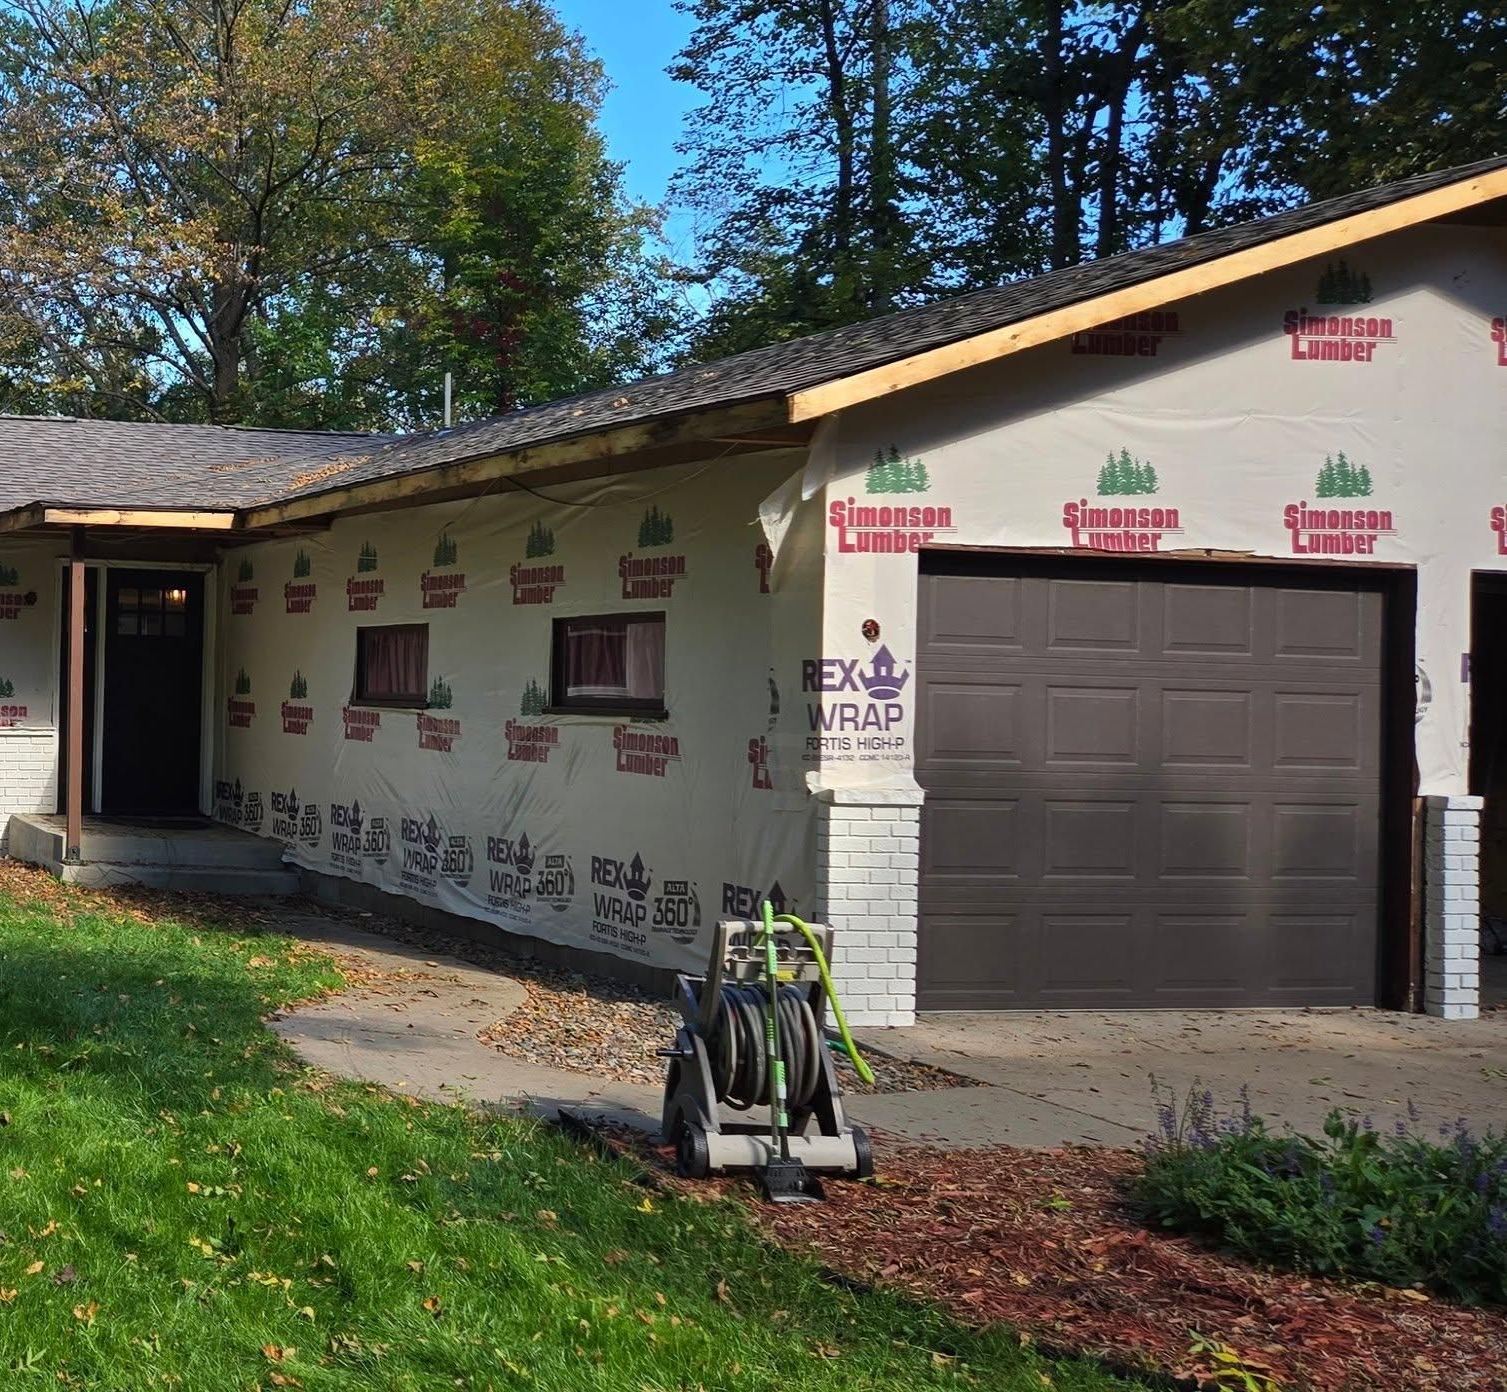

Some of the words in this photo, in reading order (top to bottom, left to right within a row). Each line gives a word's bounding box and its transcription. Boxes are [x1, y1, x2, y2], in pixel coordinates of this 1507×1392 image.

[1283, 307, 1392, 337] Simonson
[1292, 333, 1376, 361] Lumber
[829, 496, 951, 527] Simonson
[1063, 498, 1178, 528] Simonson
[1284, 500, 1392, 529] Simonson
[1071, 526, 1162, 551] Lumber
[1292, 528, 1377, 554] Lumber
[509, 561, 564, 586] Simonson
[619, 551, 686, 577] Simonson
[346, 576, 384, 595] Simonson
[420, 570, 465, 591] Simonson
[622, 576, 674, 599] Lumber
[348, 593, 378, 611] Lumber
[422, 589, 458, 609] Lumber
[512, 584, 555, 605] Lumber
[802, 659, 860, 692] REX
[342, 706, 380, 726] Simonson
[416, 711, 461, 735] Simonson
[807, 703, 903, 731] WRAP
[344, 723, 374, 742] Lumber
[419, 729, 453, 752] Lumber
[505, 718, 558, 743] Simonson
[613, 725, 678, 755] Simonson
[508, 740, 550, 763] Lumber
[806, 737, 851, 750] FORTIS
[857, 737, 905, 750] HIGH-P
[616, 750, 668, 777] Lumber
[330, 804, 349, 828] REX
[401, 817, 423, 845] REX
[332, 832, 361, 856] WRAP
[487, 835, 514, 866] REX
[404, 848, 437, 875] WRAP
[591, 855, 625, 890] REX
[489, 868, 531, 899] WRAP
[666, 883, 685, 893] ALTA
[594, 892, 646, 928] WRAP
[722, 882, 762, 920] REX
[593, 920, 618, 938] FORTIS
